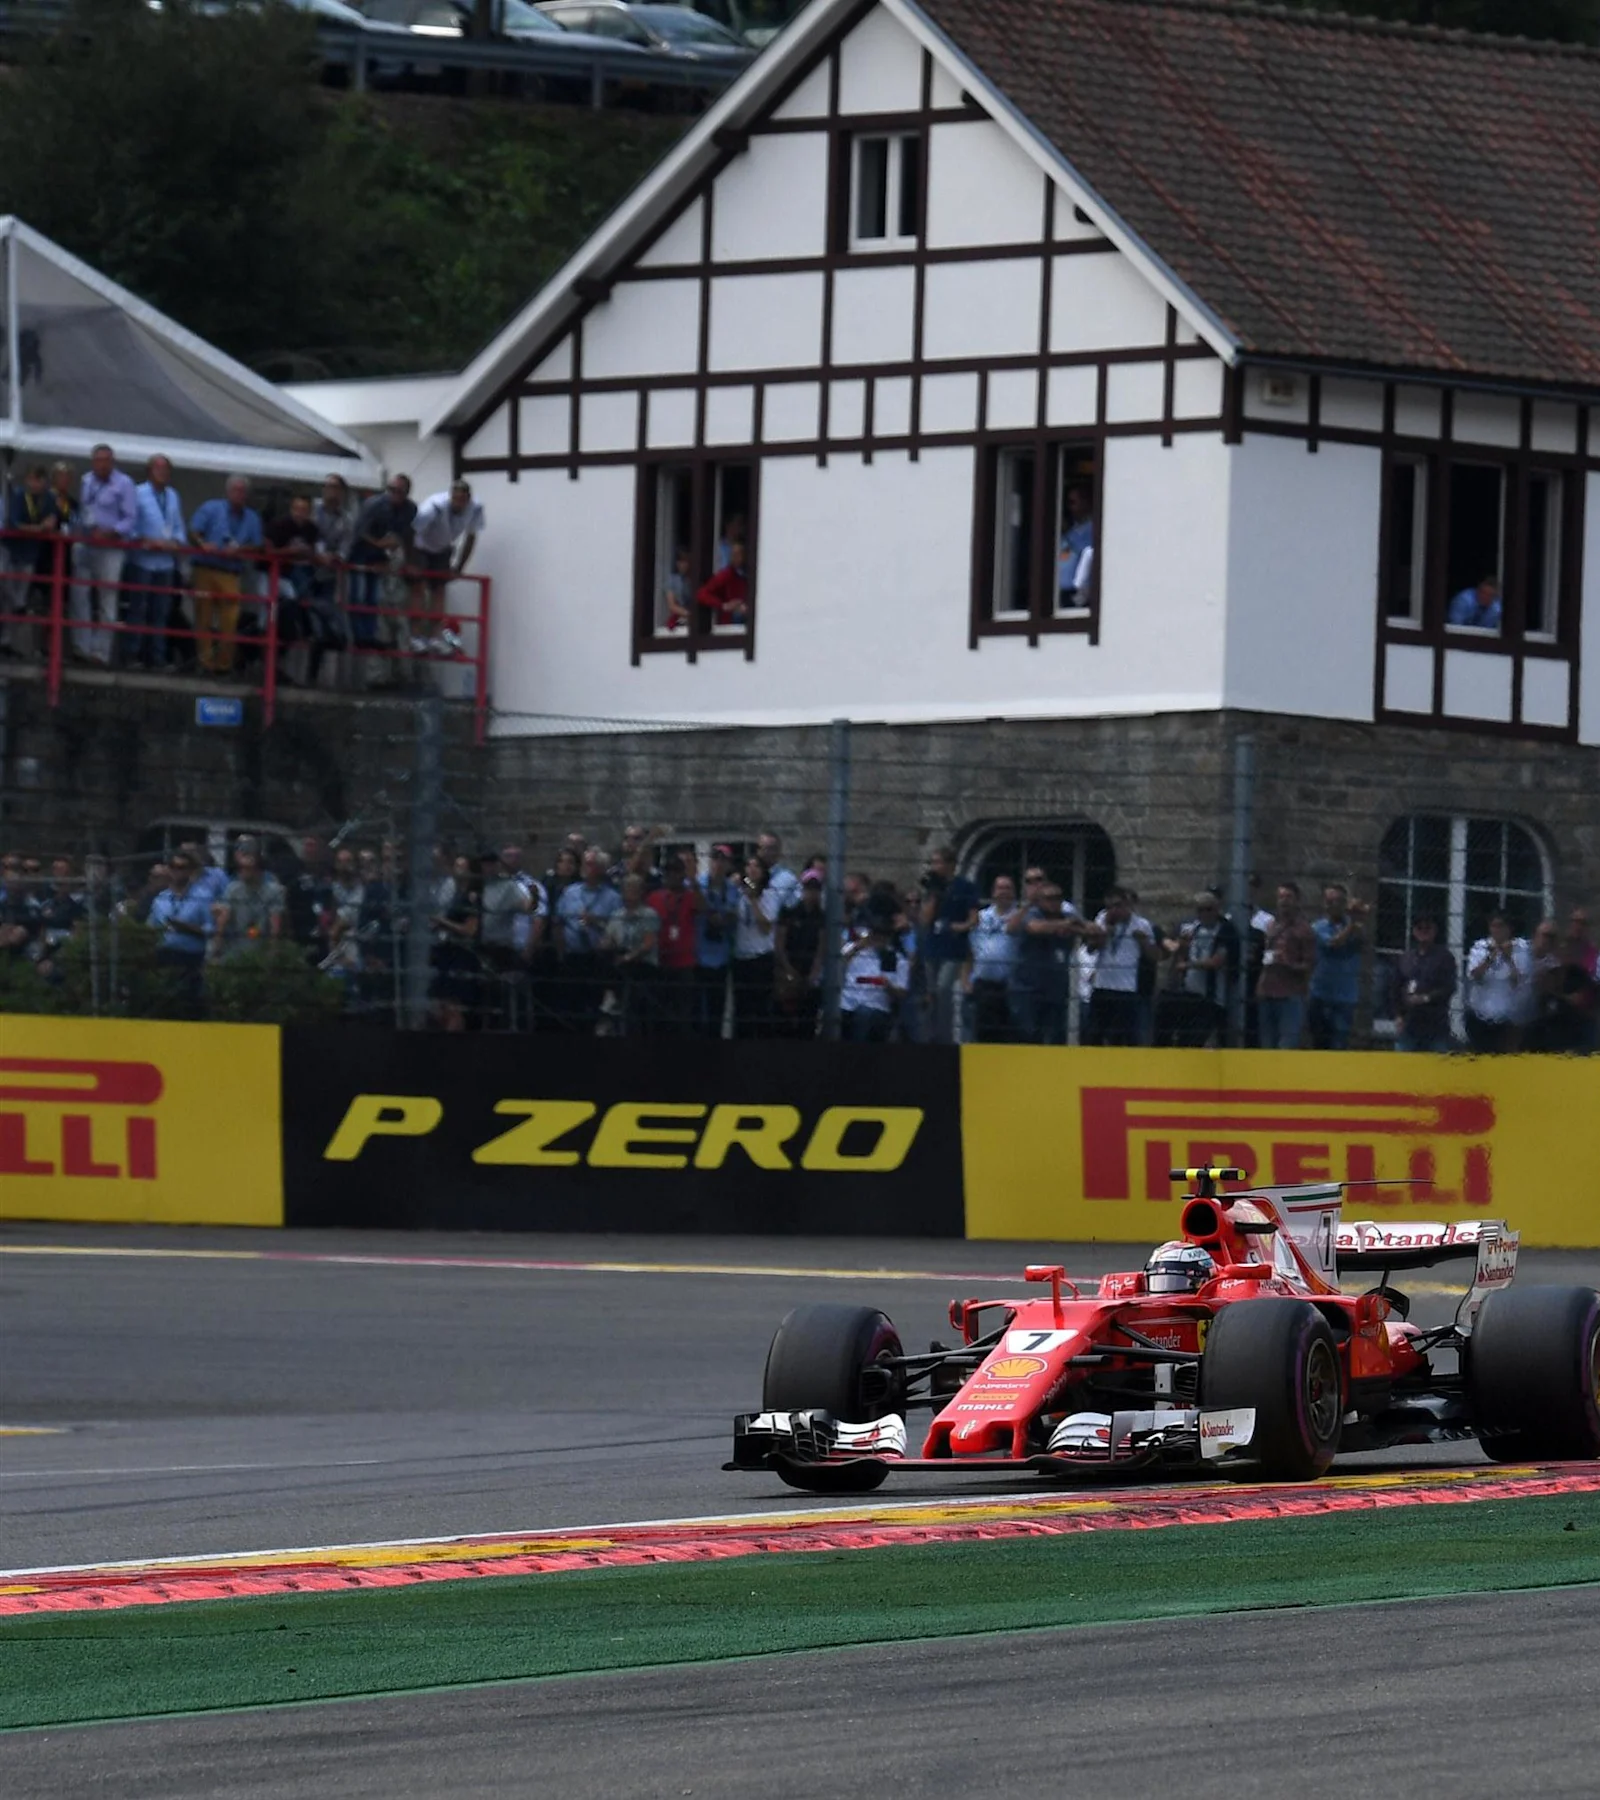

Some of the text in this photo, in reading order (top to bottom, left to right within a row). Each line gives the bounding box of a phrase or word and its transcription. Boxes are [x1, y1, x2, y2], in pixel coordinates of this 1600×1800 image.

[324, 1095, 924, 1172] P ZERO
[1079, 1087, 1496, 1205] PIRELLI
[1337, 1224, 1485, 1247] antander
[1021, 1332, 1054, 1351] 7
